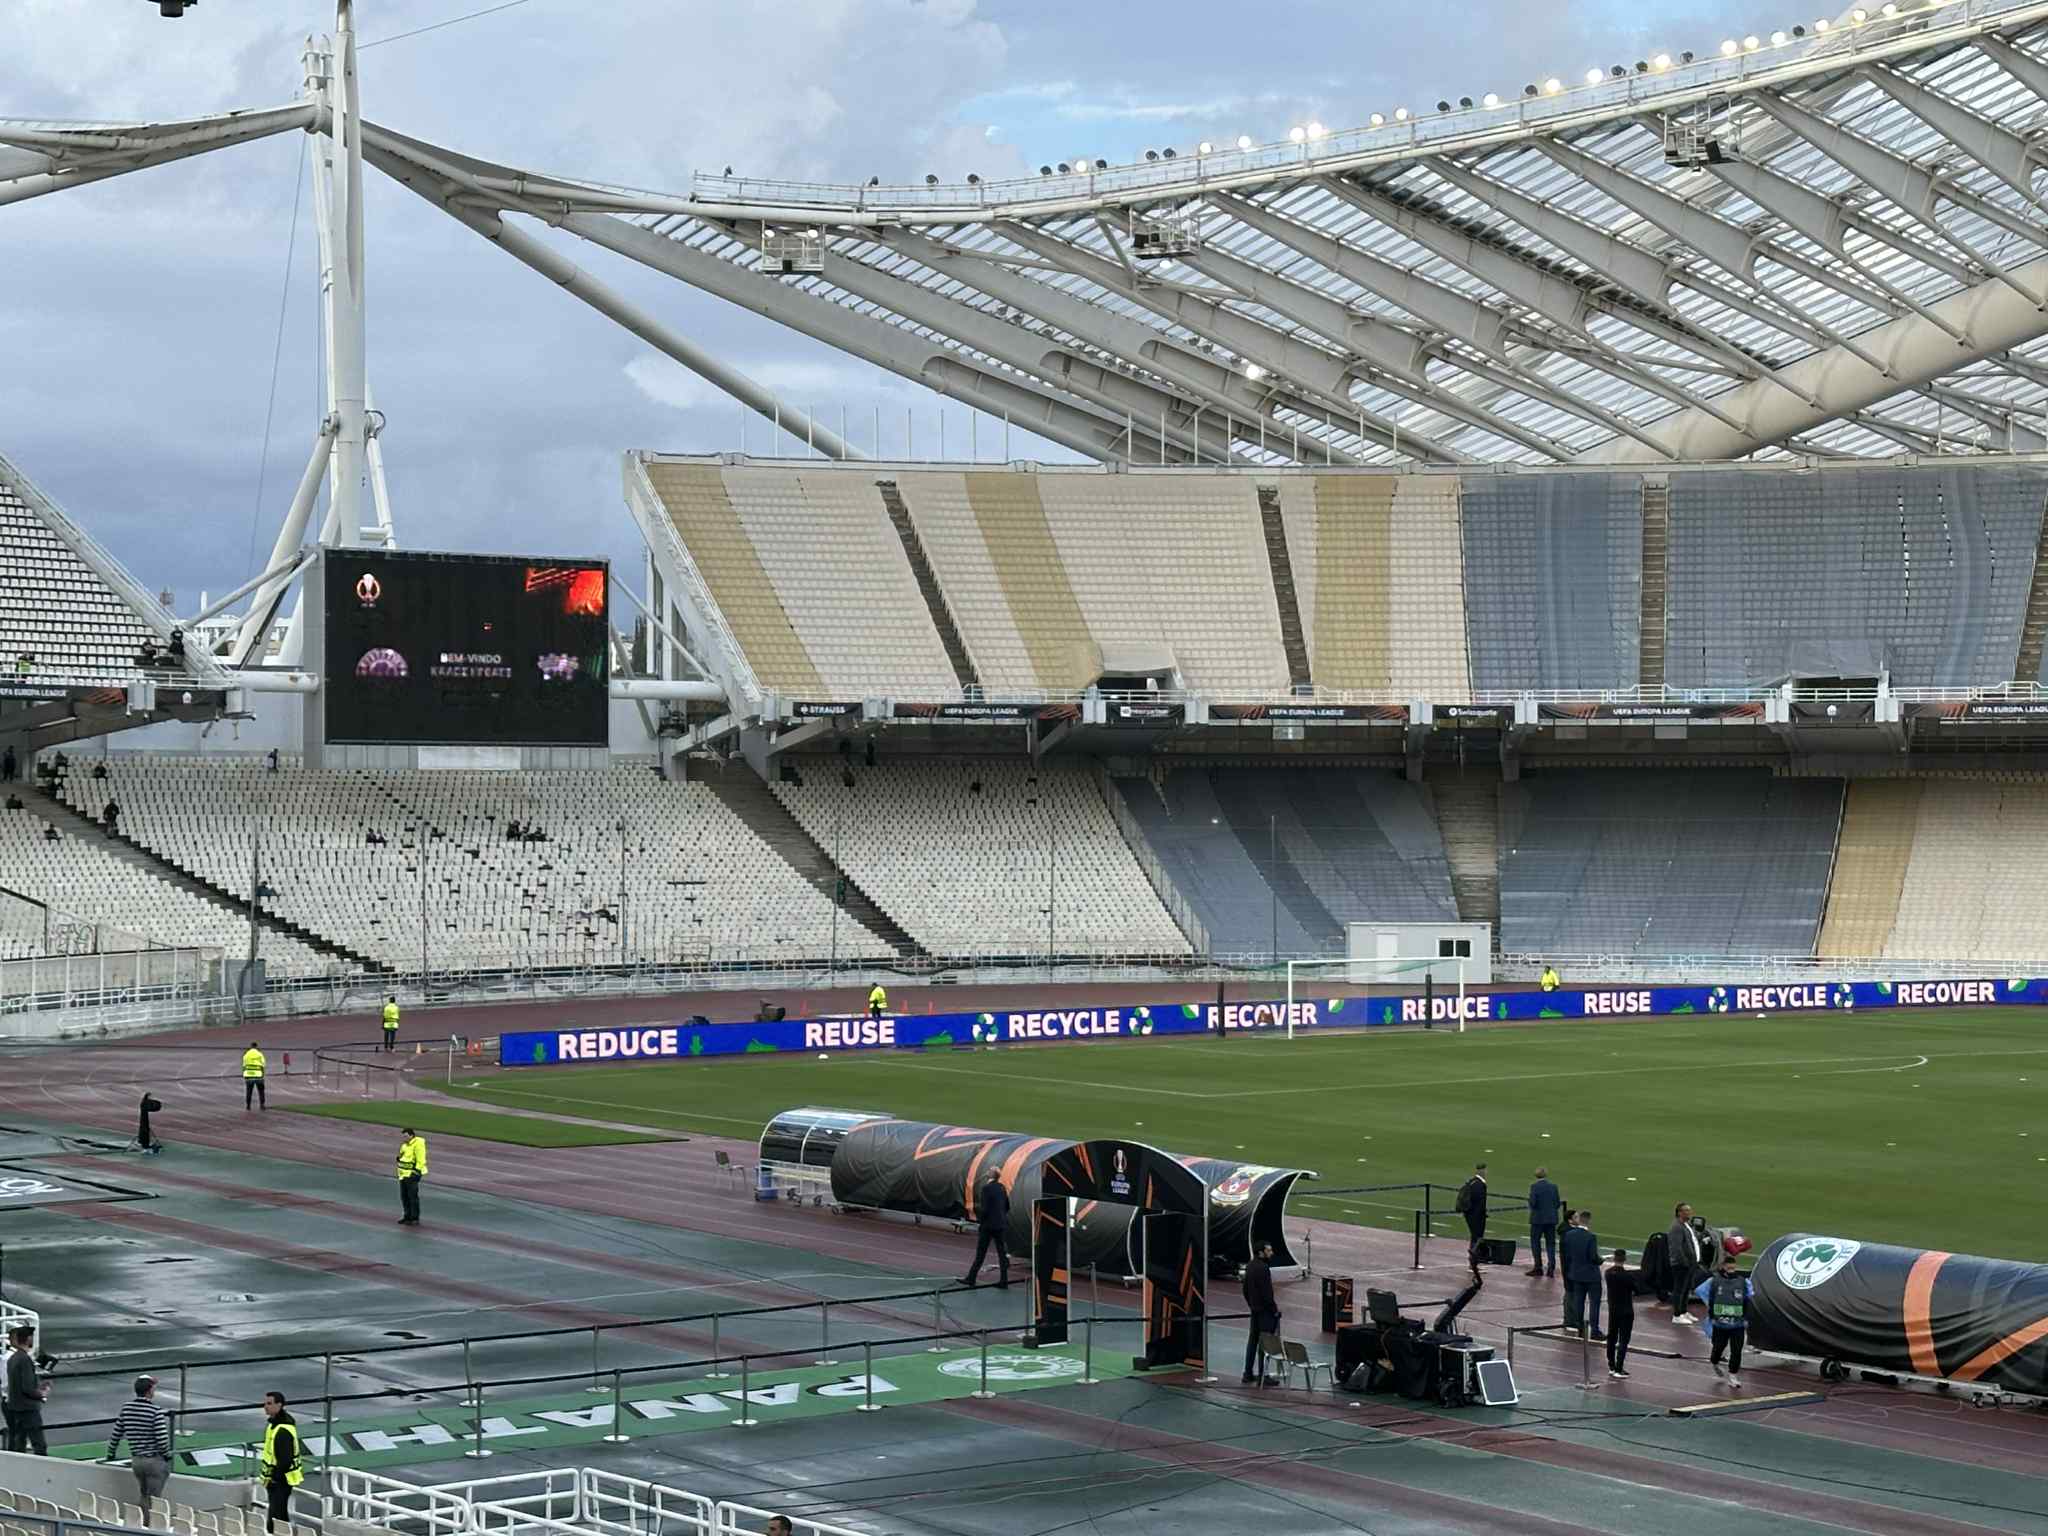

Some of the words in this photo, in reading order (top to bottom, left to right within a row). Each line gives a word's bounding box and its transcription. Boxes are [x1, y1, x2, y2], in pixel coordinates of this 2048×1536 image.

[1584, 991, 1651, 1014] REUSE
[1736, 986, 1827, 1009] RECYCLE
[1897, 982, 1996, 1005] RECOVER
[1207, 1002, 1317, 1028] RECOVER
[1402, 996, 1490, 1021] REDUCE
[805, 1020, 895, 1047] REUSE
[1008, 1011, 1120, 1038] RECYCLE
[558, 1029, 678, 1060] REDUCE
